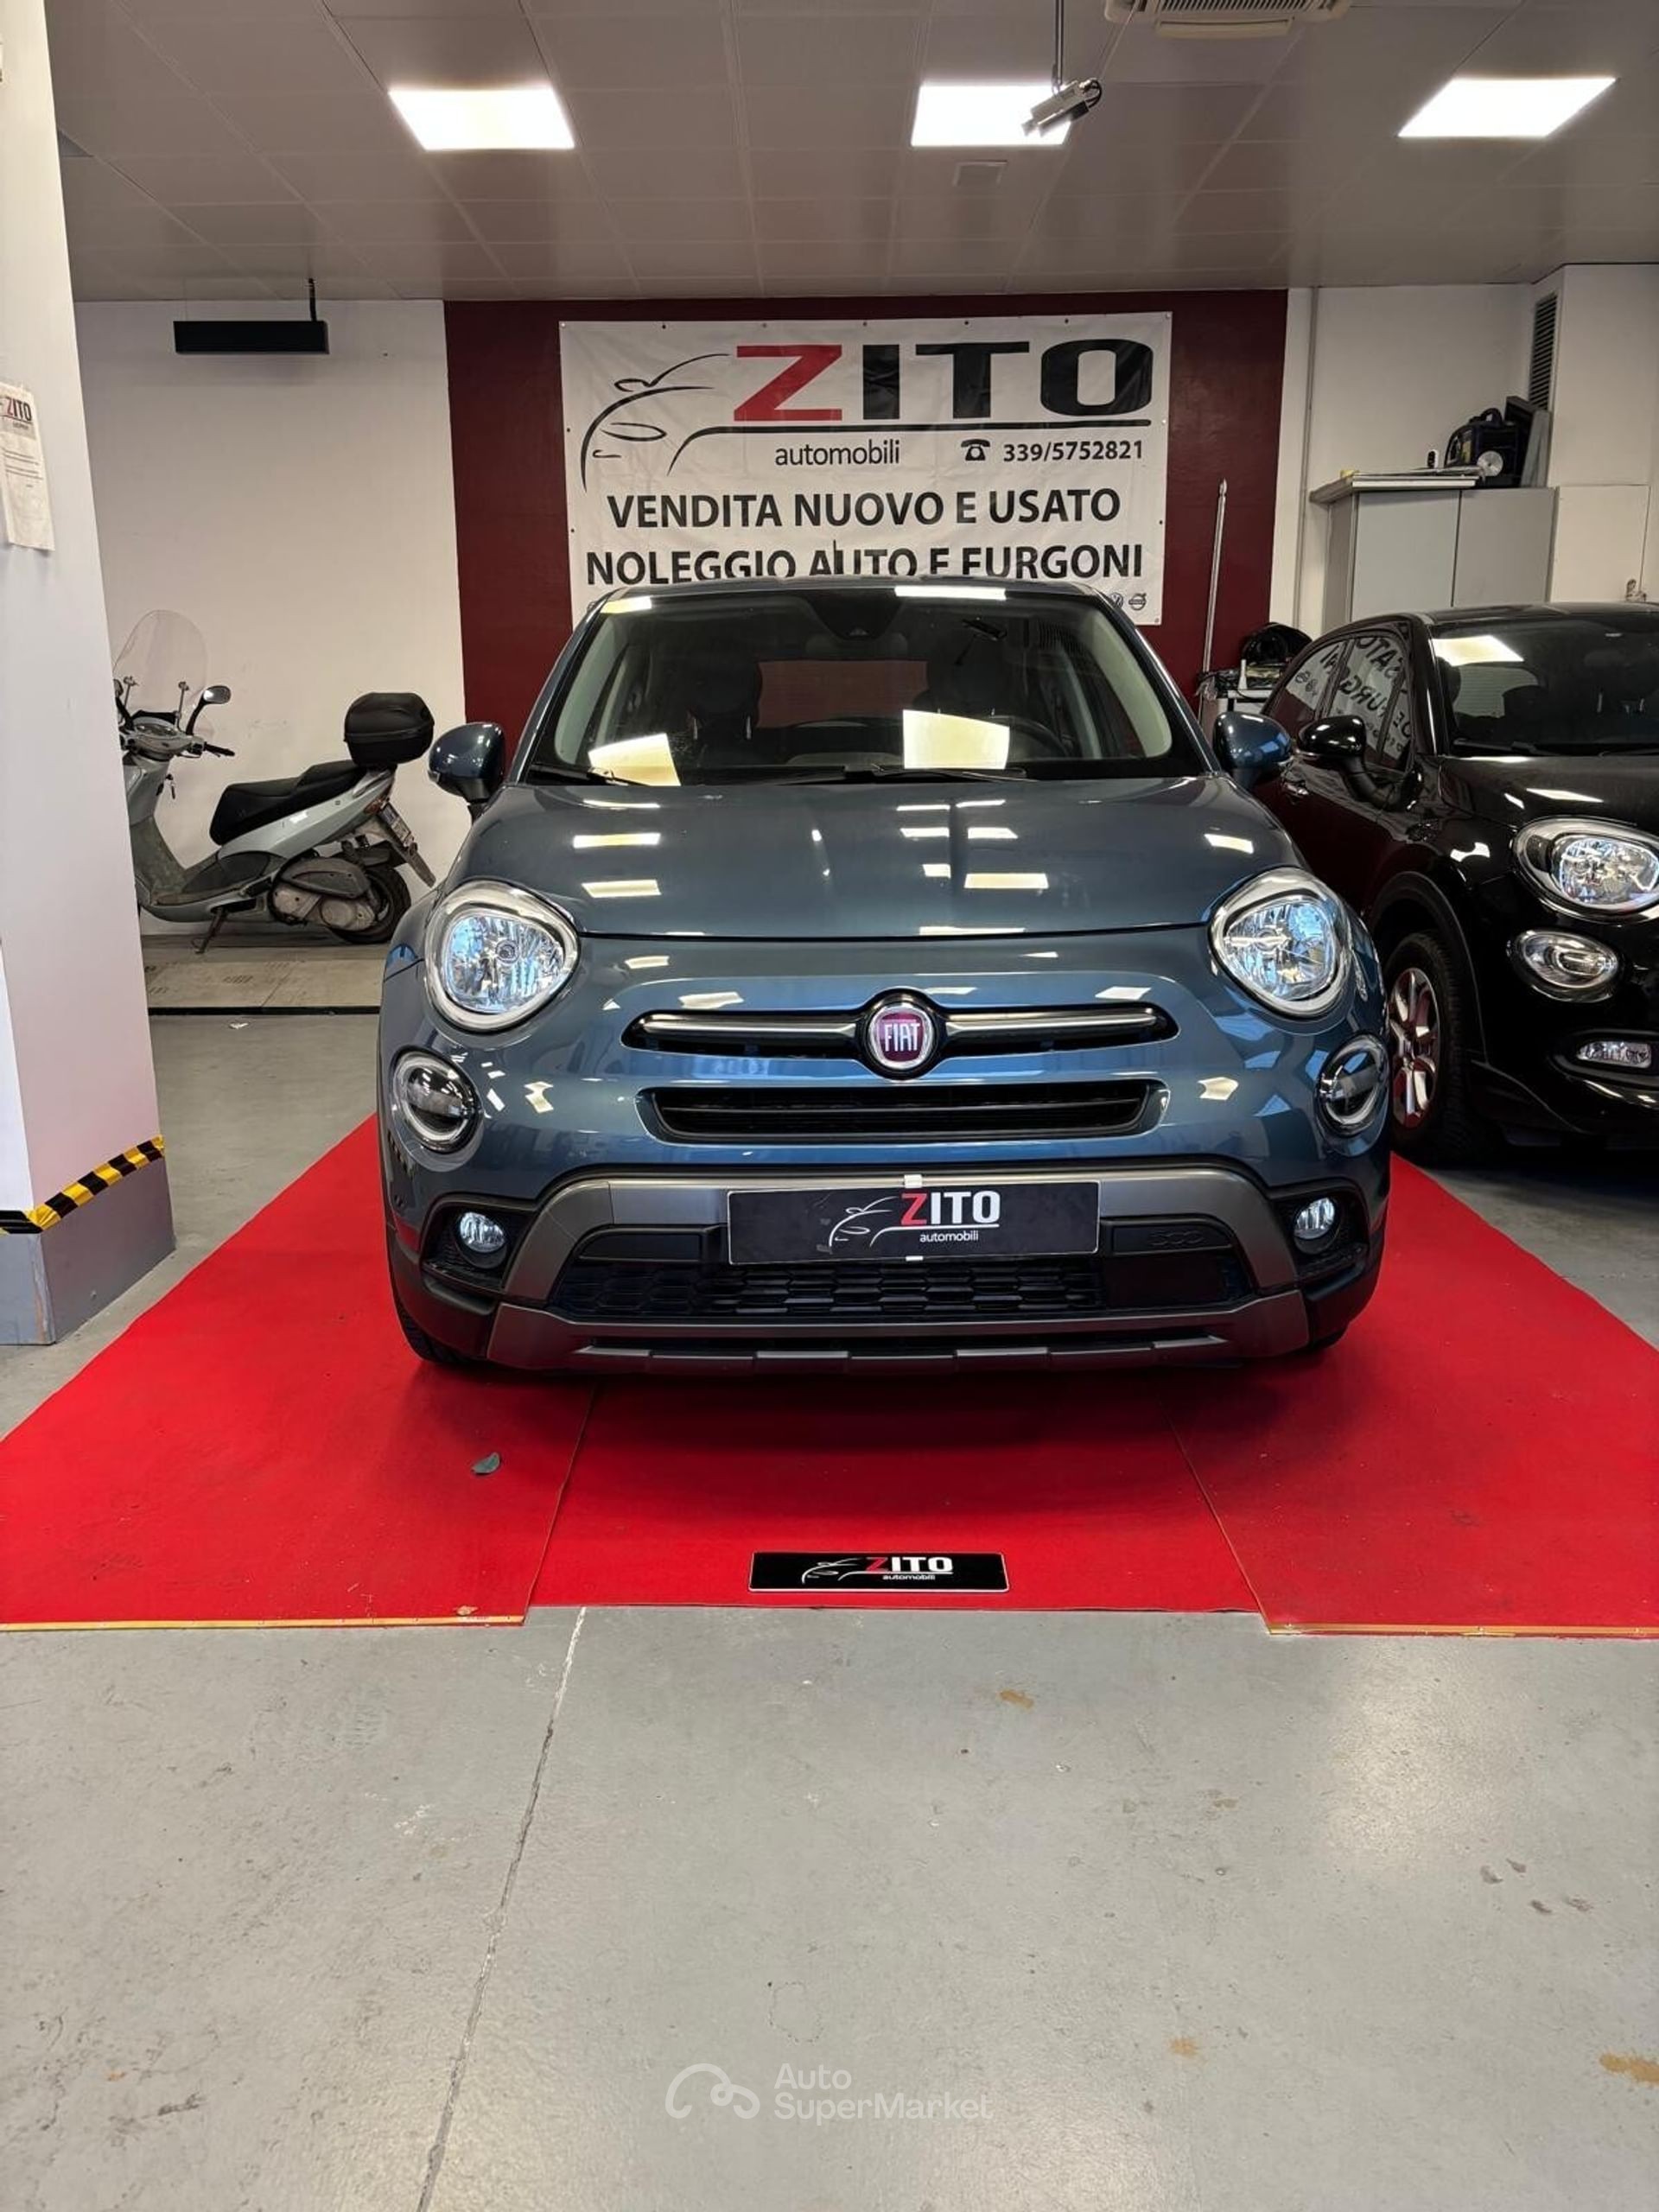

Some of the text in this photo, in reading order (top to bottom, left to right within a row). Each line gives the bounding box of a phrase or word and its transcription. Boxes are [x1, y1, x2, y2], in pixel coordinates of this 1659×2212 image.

[734, 338, 1154, 421] ZITO
[5, 395, 32, 422] ZITO
[775, 439, 1143, 466] automobili 339/5752821
[607, 487, 1122, 529] VENDITA NUOVO E USATO
[587, 550, 797, 585] NOLEGGIO
[809, 547, 918, 576] AUTO
[961, 543, 1142, 579] FURGONI
[883, 1022, 920, 1052] FIAT
[900, 1190, 1001, 1226] ZITO
[919, 1230, 979, 1243] automobili
[865, 1556, 953, 1573] ZITO
